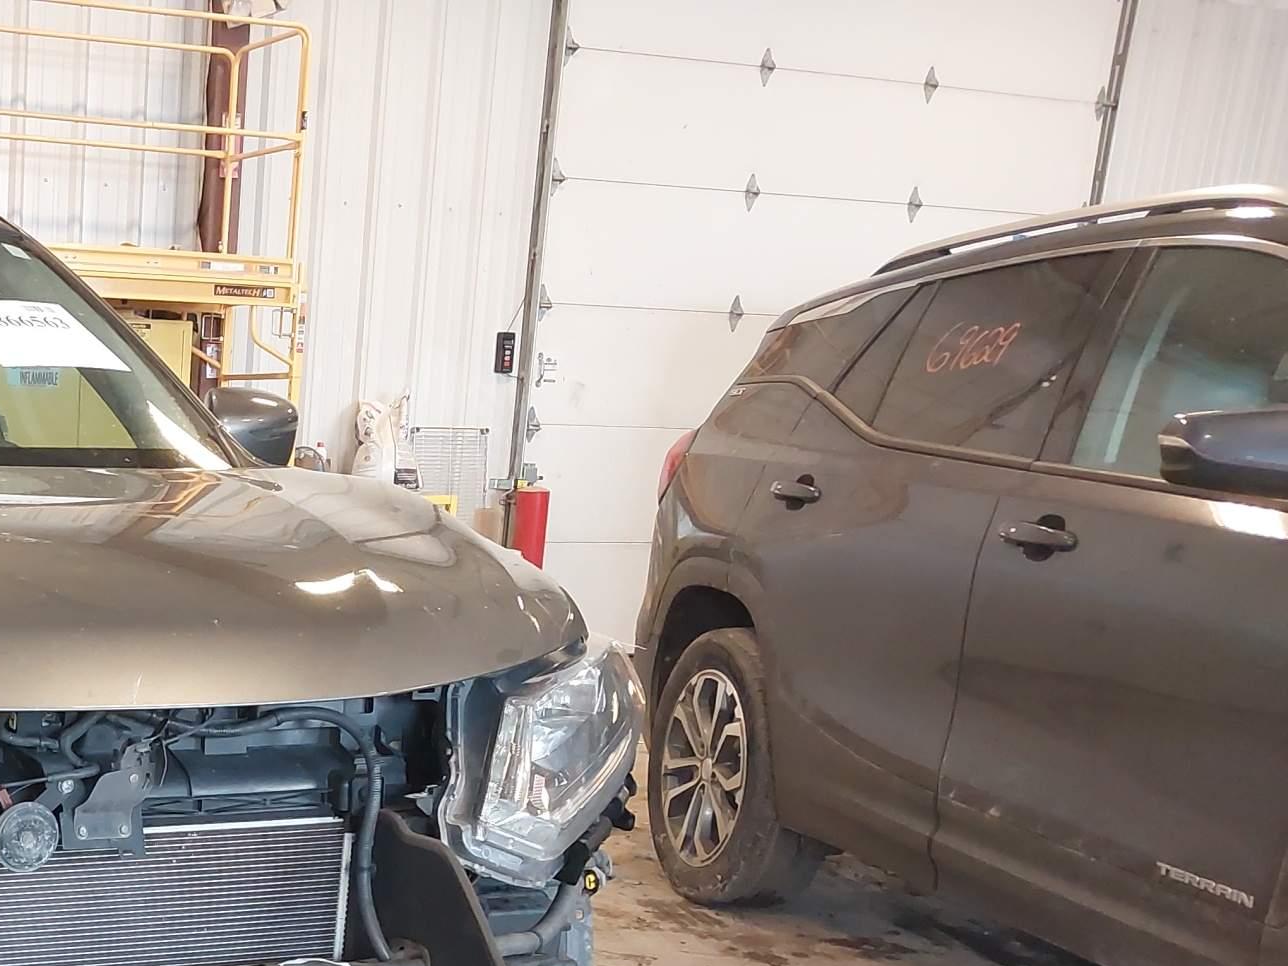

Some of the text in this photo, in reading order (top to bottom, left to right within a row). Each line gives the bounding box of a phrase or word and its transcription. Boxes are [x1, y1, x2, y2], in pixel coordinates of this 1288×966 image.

[215, 286, 261, 298] METALTECH
[19, 371, 59, 386] INFLAMMABLE
[1155, 860, 1255, 909] TERRAIN
